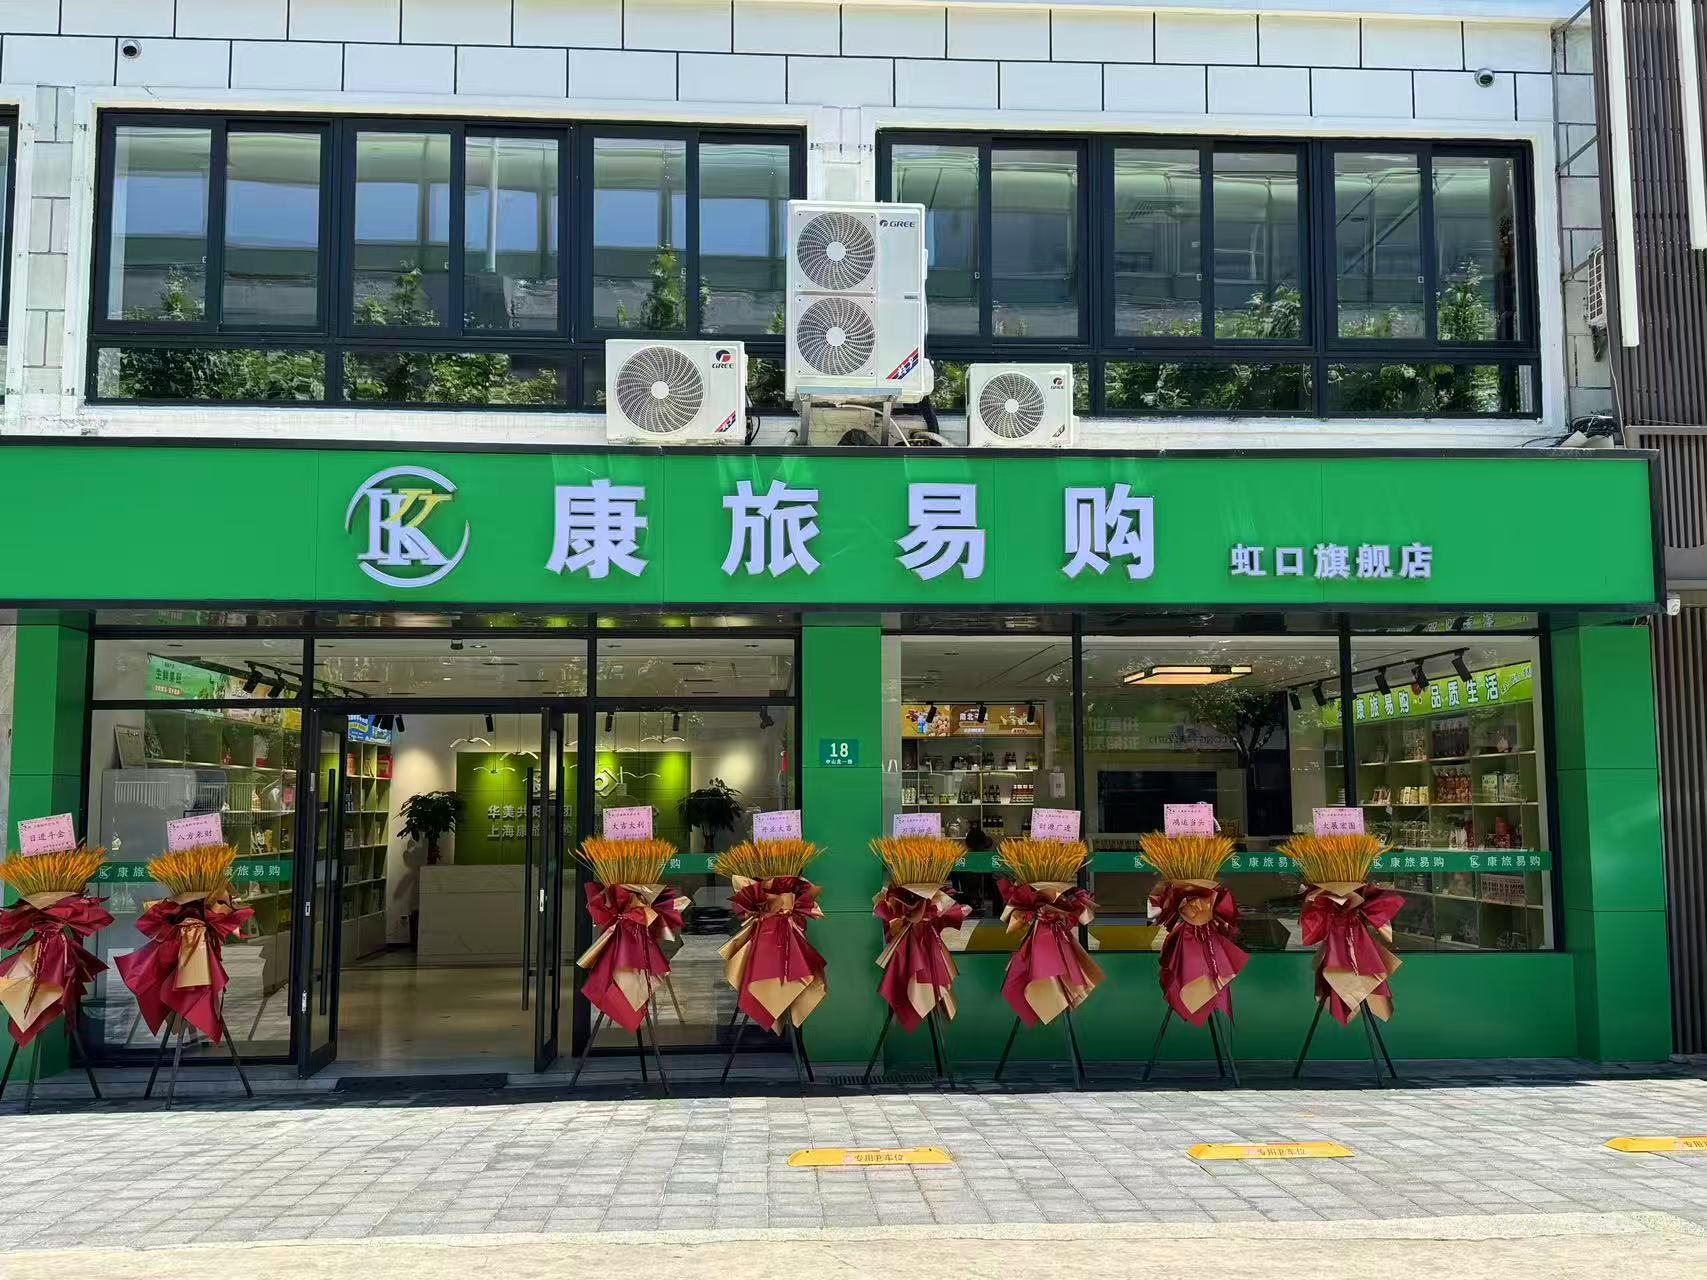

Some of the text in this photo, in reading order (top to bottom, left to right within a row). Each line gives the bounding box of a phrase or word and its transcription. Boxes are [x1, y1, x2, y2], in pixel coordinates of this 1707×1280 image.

[889, 220, 916, 228] GREE
[545, 479, 1155, 580] 康旅易购
[1230, 542, 1434, 579] 虹口旗舰店
[830, 742, 849, 758] 18
[612, 821, 645, 831] 大吉大利
[1039, 823, 1072, 832] 财源广进
[1172, 818, 1205, 827] 鸿运当头
[1323, 821, 1357, 831] 大展宏图
[762, 824, 793, 834] 开业大吉
[30, 829, 66, 842] 日进斗金
[177, 830, 213, 841] 八方来财
[1390, 856, 1445, 868] 康旅易购
[1487, 855, 1541, 867] 康旅易购
